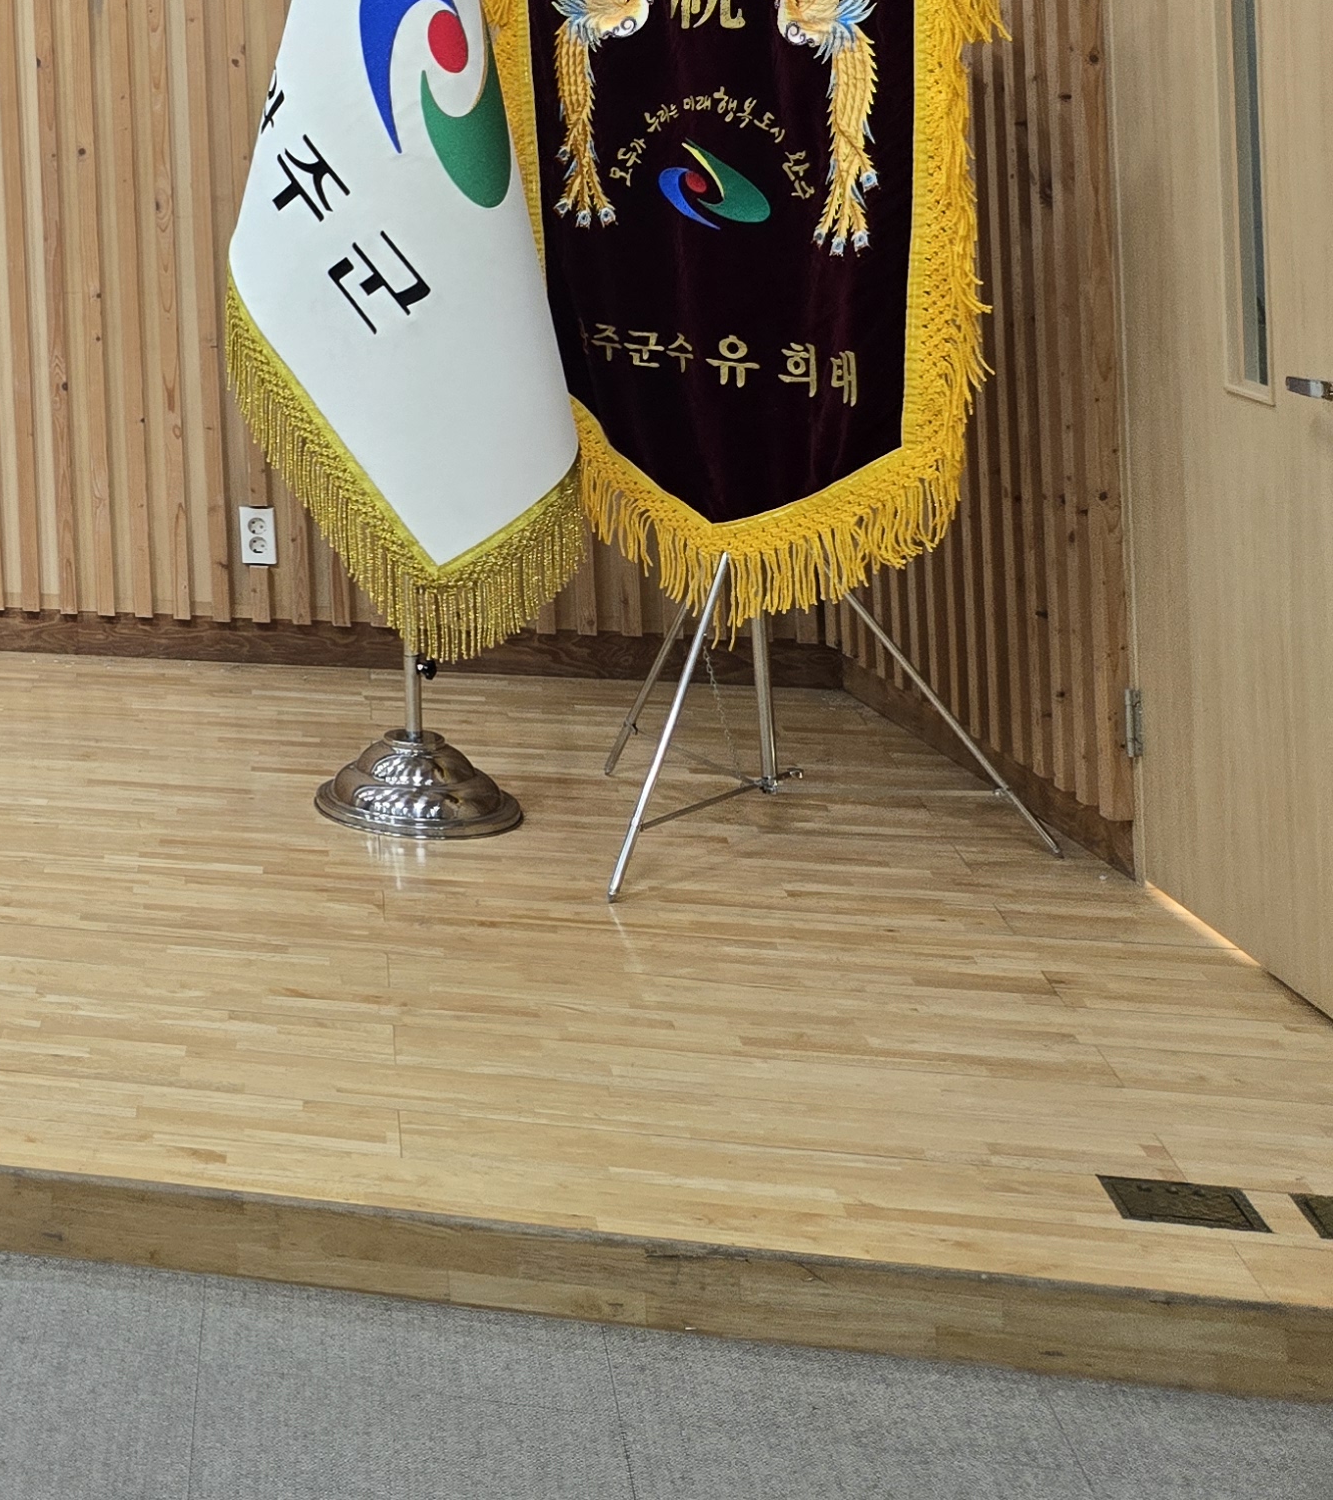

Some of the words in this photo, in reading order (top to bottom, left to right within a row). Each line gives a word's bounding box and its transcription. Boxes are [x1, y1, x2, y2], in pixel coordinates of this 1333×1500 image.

[609, 138, 647, 187] 모두가
[644, 104, 680, 132] 누리는
[782, 150, 815, 200] 완주
[579, 317, 694, 373] 주군수
